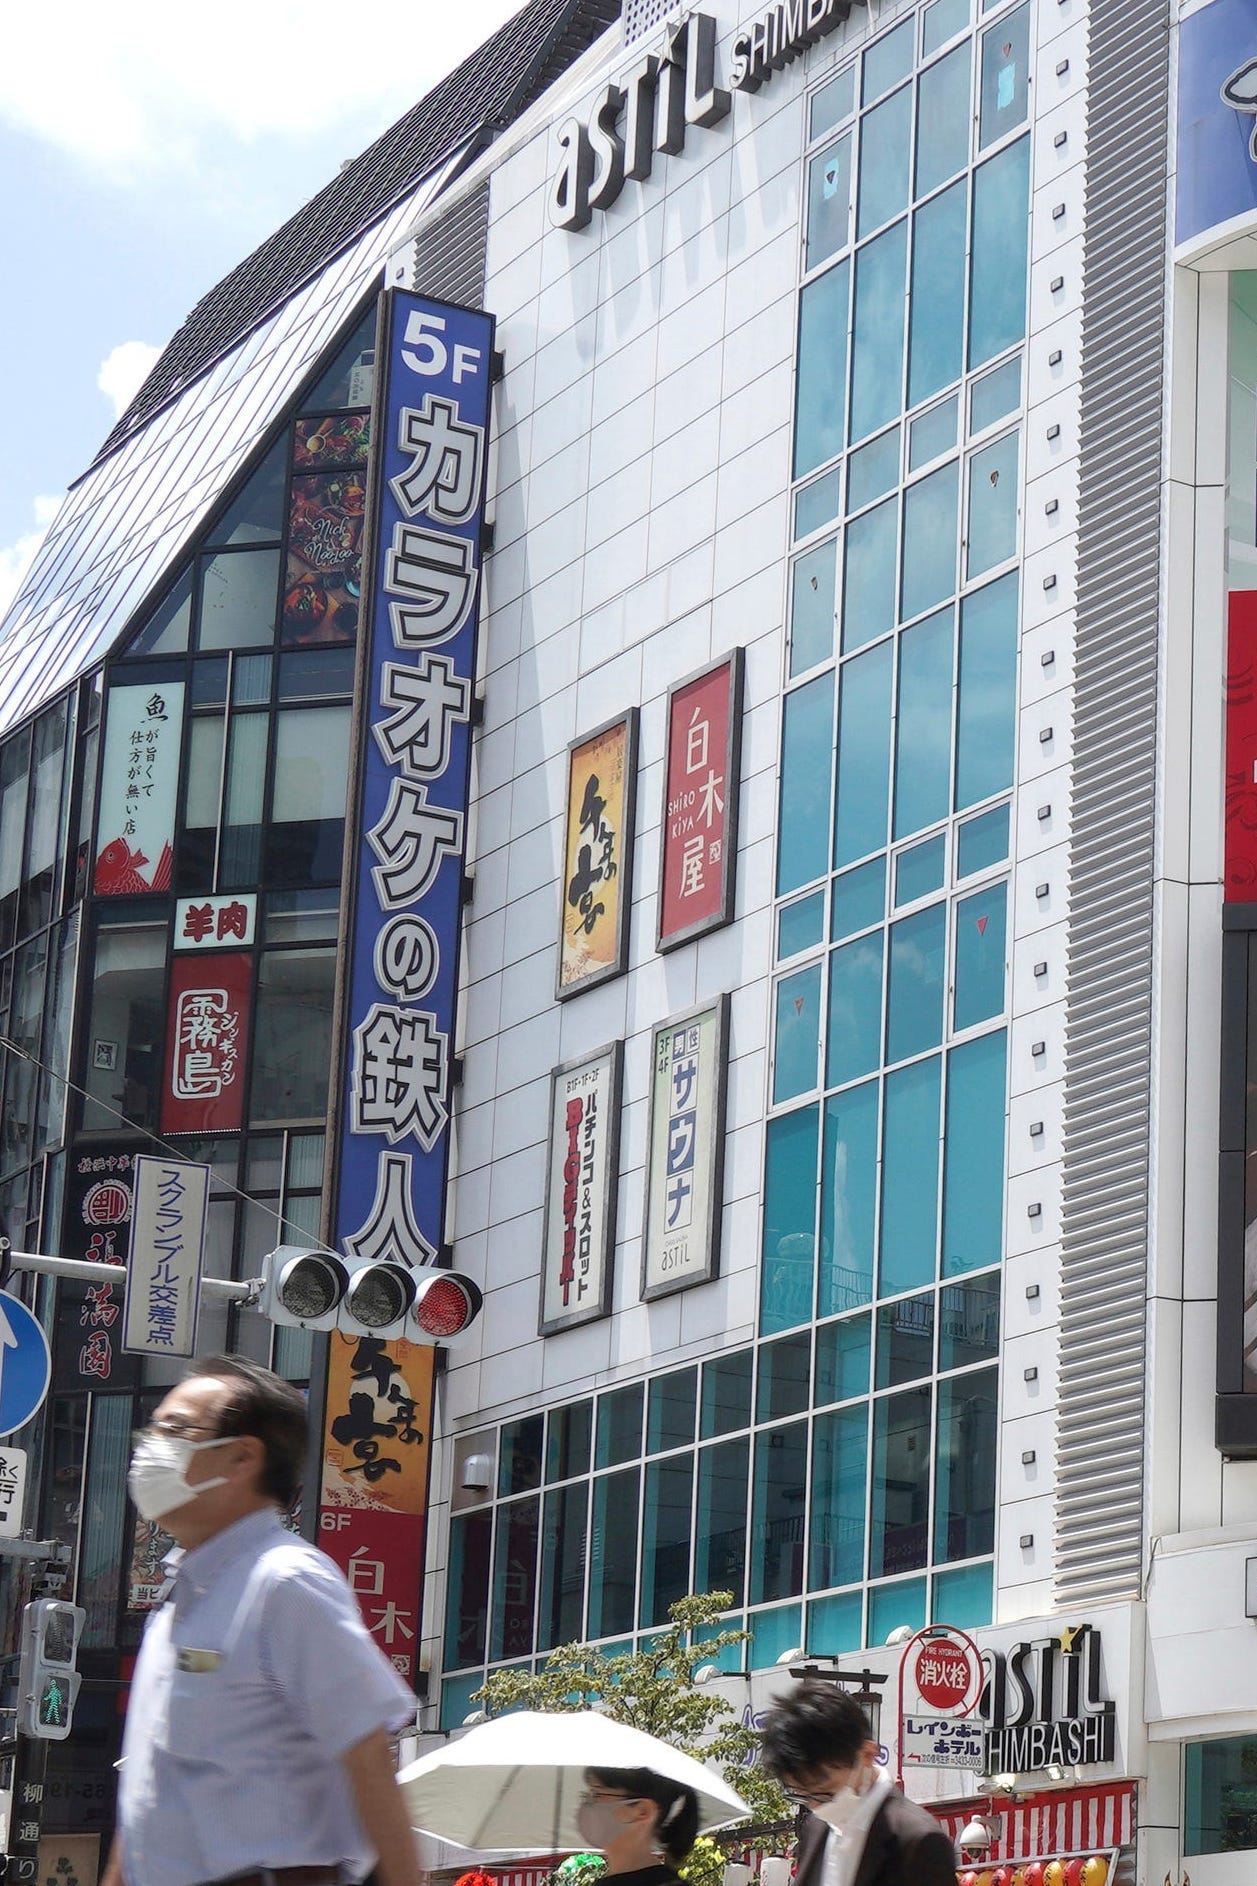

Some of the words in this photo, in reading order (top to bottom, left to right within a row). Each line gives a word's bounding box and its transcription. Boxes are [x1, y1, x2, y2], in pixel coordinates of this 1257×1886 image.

[400, 309, 481, 384] 5F
[122, 730, 145, 836] 仕方が無い店
[679, 707, 724, 899] 白木屋
[342, 392, 485, 1268] カラオケの鉄人
[183, 901, 248, 942] 羊肉
[219, 1011, 239, 1086] ジンギスカン
[668, 1058, 696, 1228] サウナ
[146, 1169, 186, 1346] スクランブル交差点
[320, 1511, 351, 1532] 6F
[919, 1658, 967, 1690] 消火栓
[907, 1720, 982, 1738] レインボー
[934, 1739, 981, 1756] ホテル
[974, 1714, 1115, 1777] HIMBASHI
[19, 1783, 44, 1879] 柳通り
